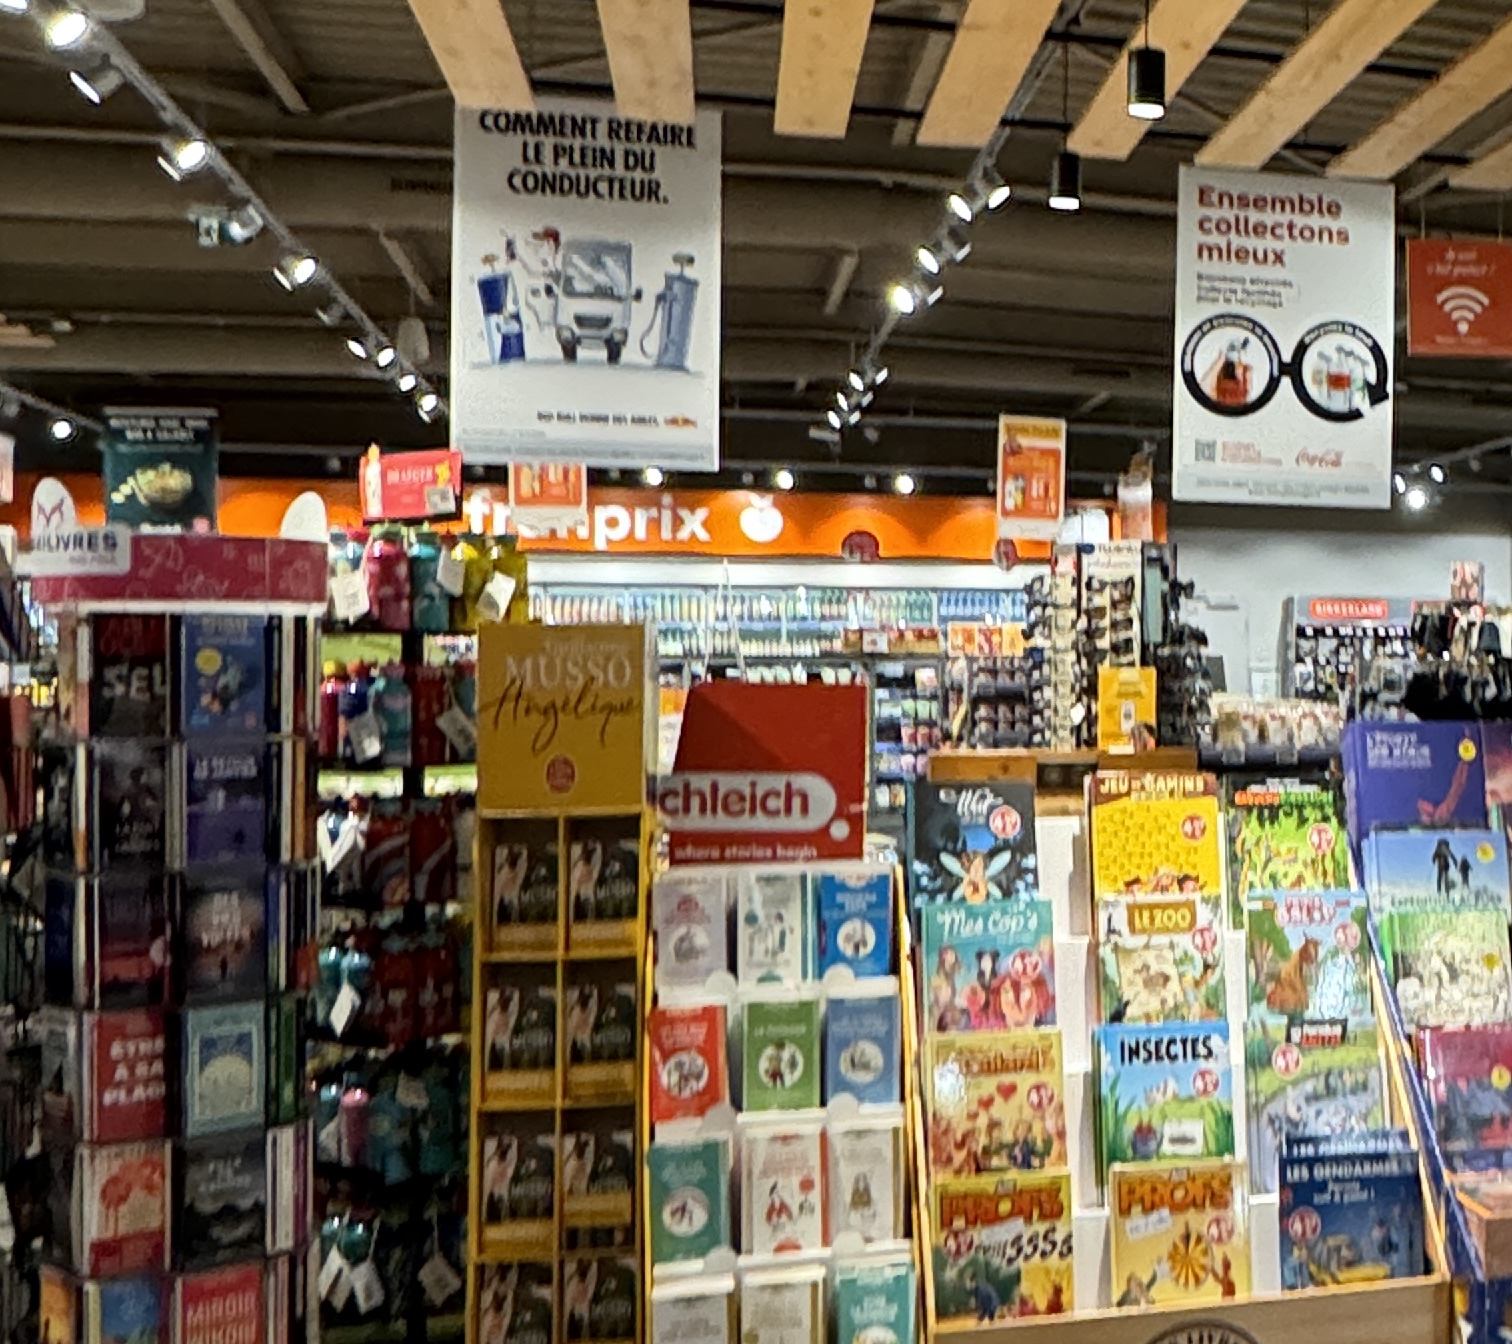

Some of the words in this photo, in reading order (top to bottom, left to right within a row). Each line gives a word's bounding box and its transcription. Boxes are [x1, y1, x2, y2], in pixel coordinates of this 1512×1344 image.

[479, 110, 598, 140] COMMENT
[521, 140, 546, 166] LE
[552, 142, 616, 171] PLEIN
[624, 146, 656, 175] DU
[507, 168, 670, 205] CONDUCTEUR.
[1197, 184, 1343, 218] Ensemble
[1197, 213, 1351, 246] collectons
[1196, 240, 1287, 268] mieux
[462, 487, 712, 551] frprix
[505, 654, 633, 690] MUSSO
[657, 778, 810, 819] chleich
[1152, 907, 1193, 930] ZOO
[1119, 1034, 1214, 1066] INSECTES
